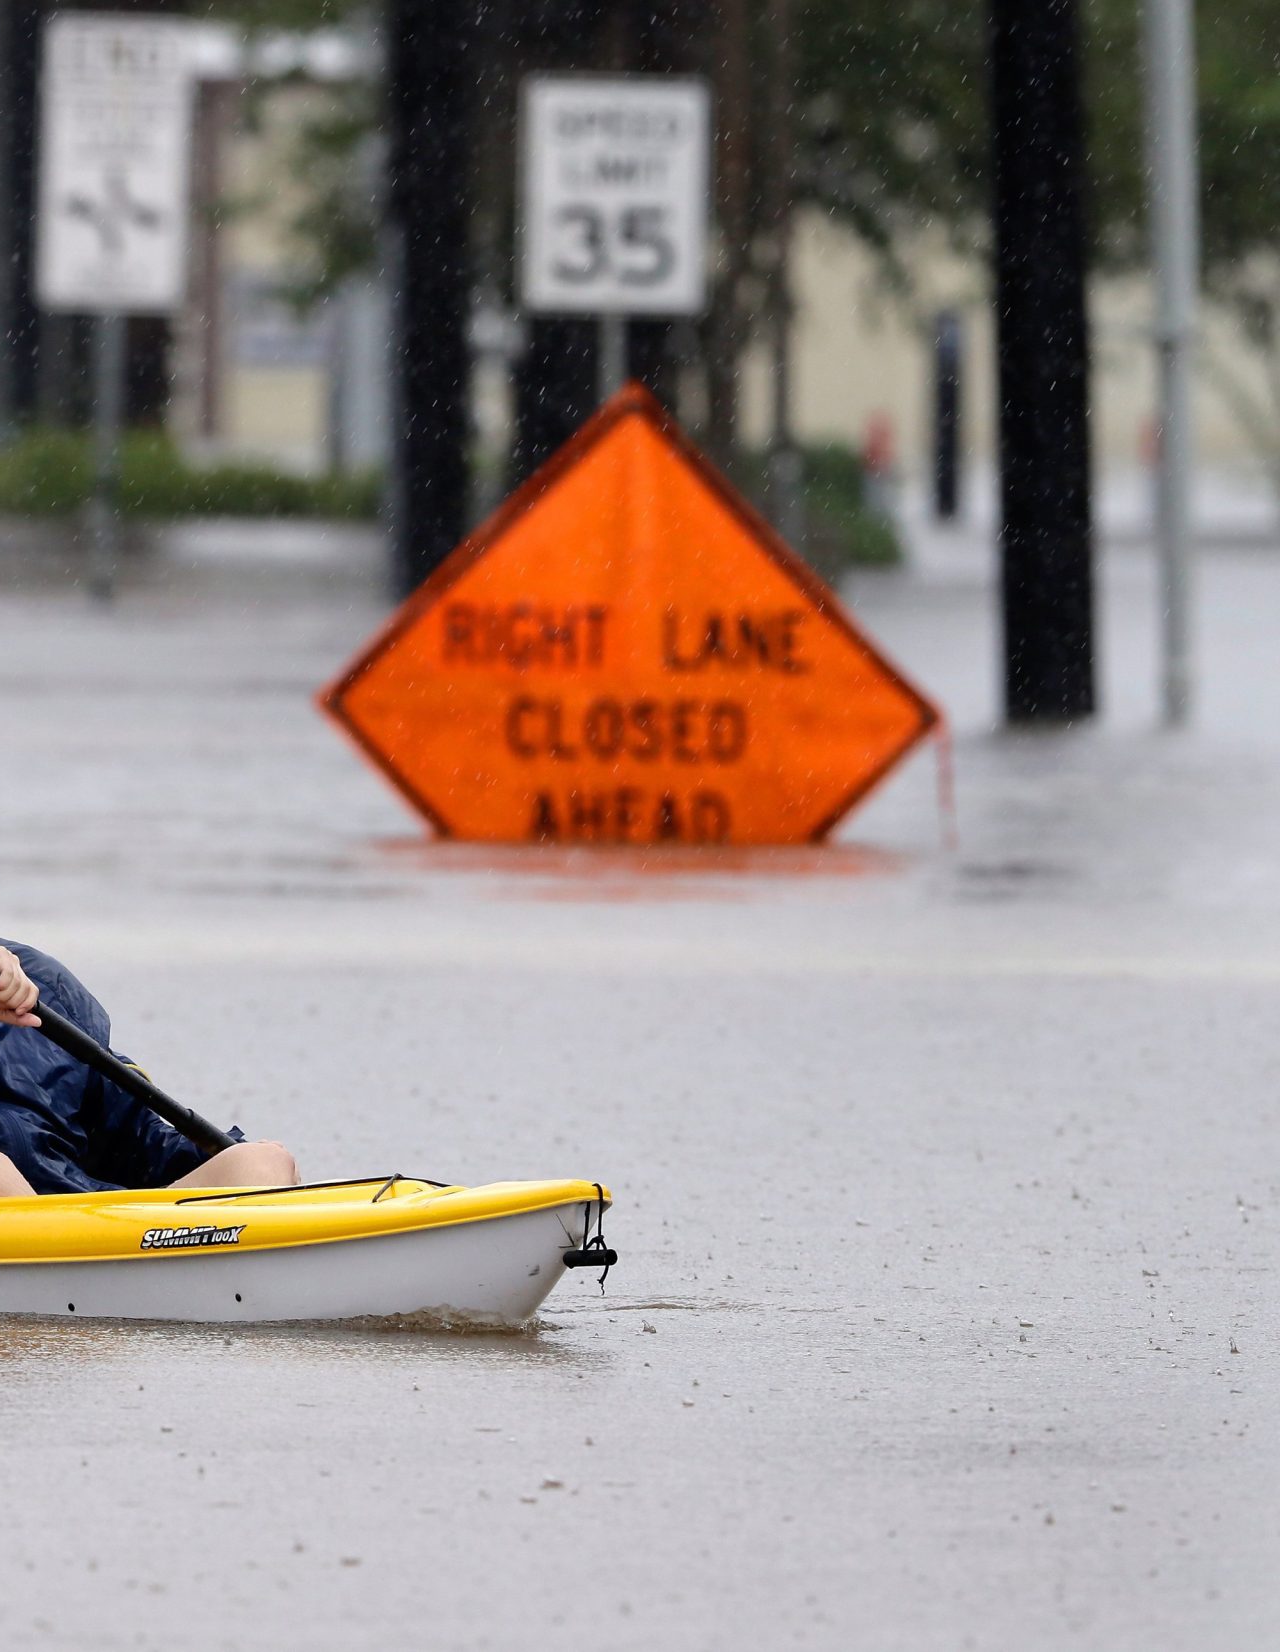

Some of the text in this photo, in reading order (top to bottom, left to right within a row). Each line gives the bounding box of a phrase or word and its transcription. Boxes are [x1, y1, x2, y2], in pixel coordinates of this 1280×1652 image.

[556, 110, 679, 142] SPEED
[560, 154, 669, 188] LIMIT
[551, 203, 677, 287] 35
[440, 604, 809, 673] RIGHT LANE
[505, 696, 747, 764] CLOSED
[530, 790, 731, 843] AHEAD
